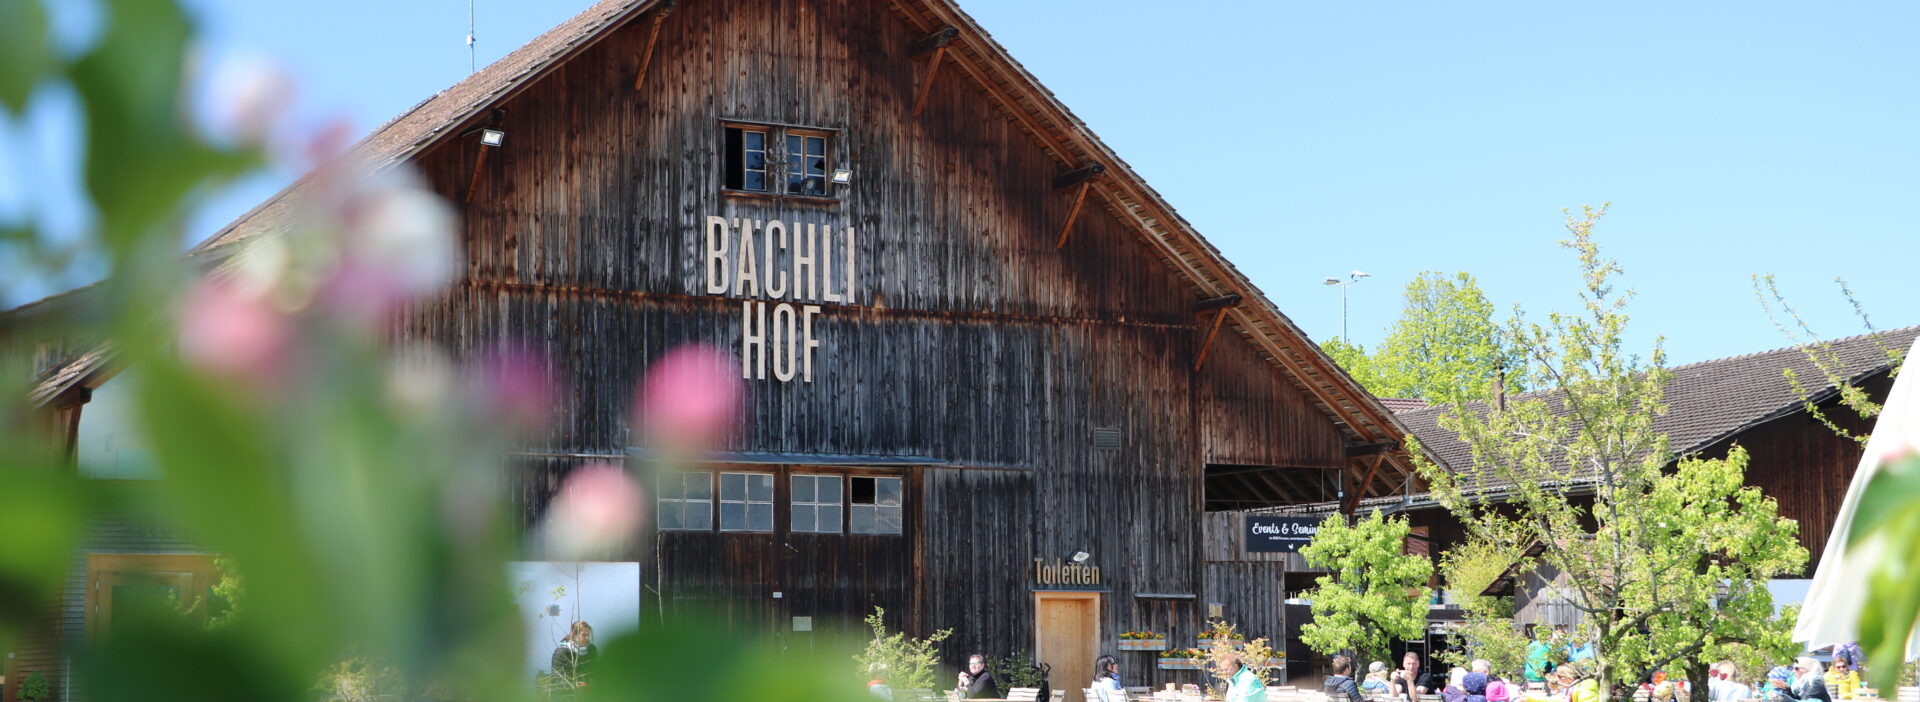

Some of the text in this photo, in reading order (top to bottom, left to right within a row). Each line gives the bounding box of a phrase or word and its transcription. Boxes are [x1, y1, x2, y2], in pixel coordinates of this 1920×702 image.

[706, 215, 855, 303] BÄCHLI
[743, 300, 821, 382] HOF
[1252, 522, 1319, 535] Events & Semin
[1034, 558, 1100, 585] Toiletten
